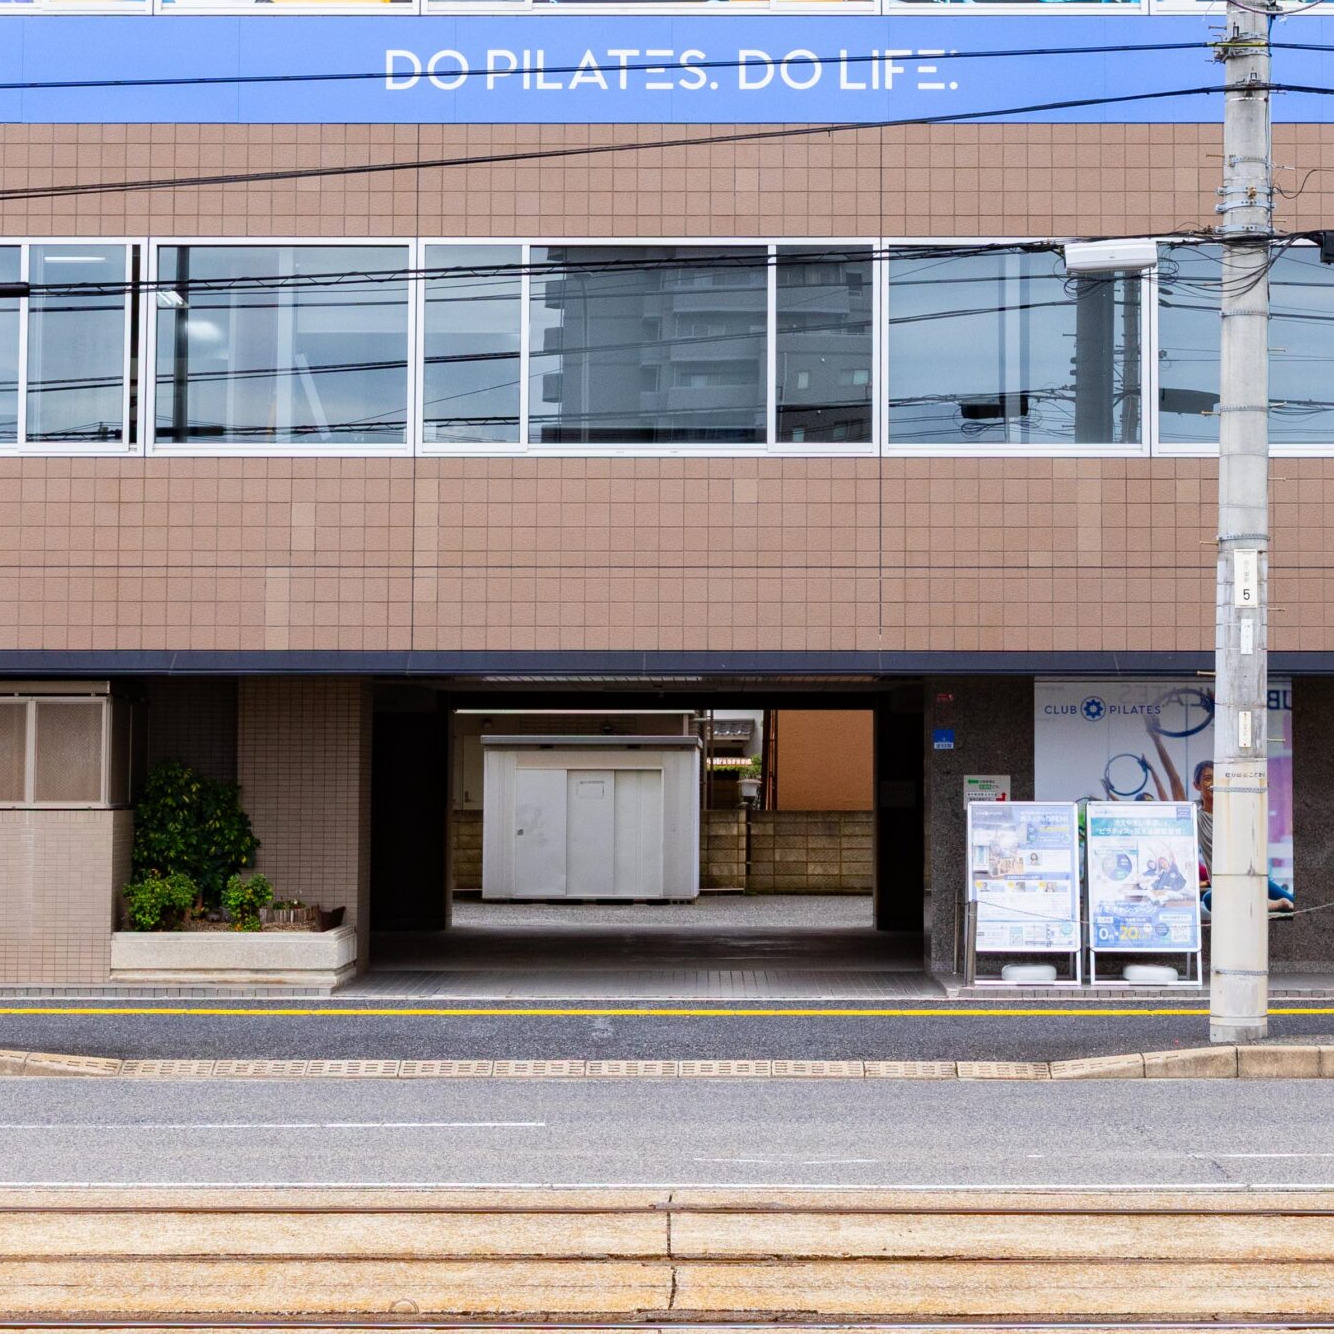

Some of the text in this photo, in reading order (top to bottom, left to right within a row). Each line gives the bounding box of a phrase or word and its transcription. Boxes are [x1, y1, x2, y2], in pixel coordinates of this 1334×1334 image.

[385, 49, 468, 90] DO
[487, 49, 719, 91] PILATES.
[738, 49, 822, 90] DO
[1044, 704, 1078, 715] CLUB
